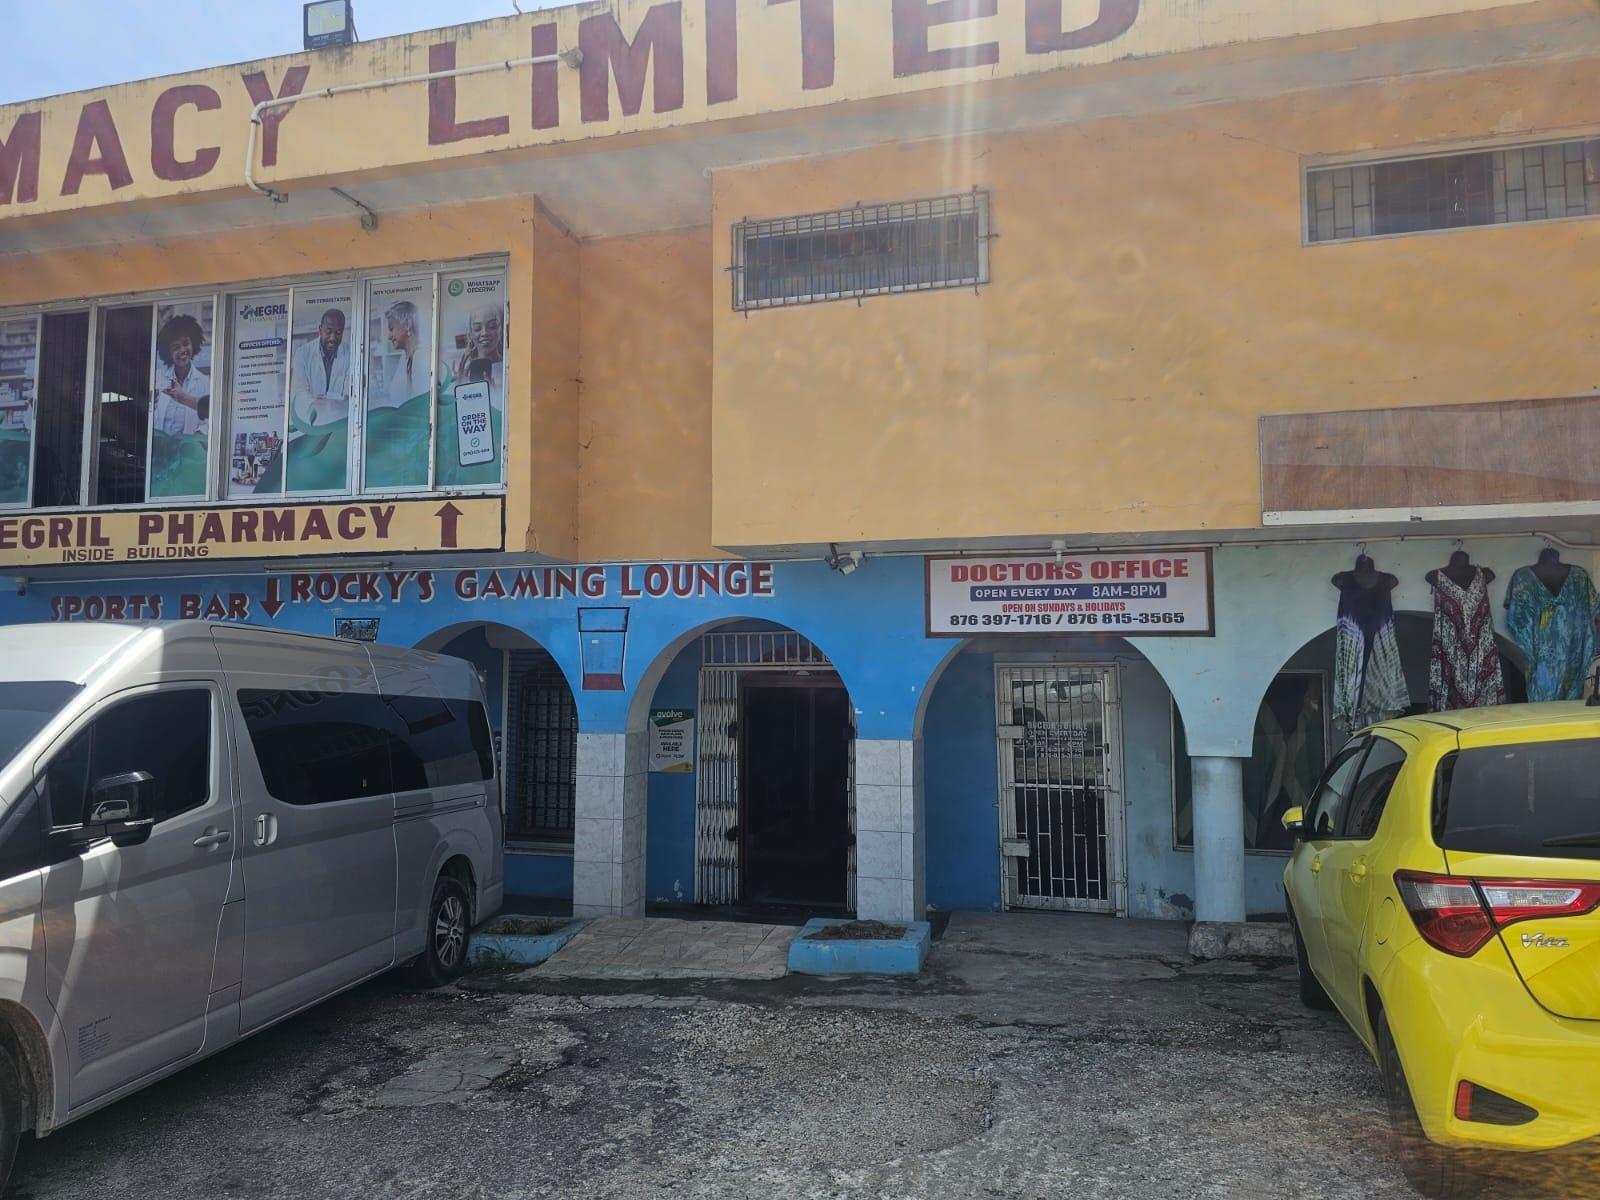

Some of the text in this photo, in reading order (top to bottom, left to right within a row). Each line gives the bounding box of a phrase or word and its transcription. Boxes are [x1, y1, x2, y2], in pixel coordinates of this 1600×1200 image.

[0, 65, 310, 204] MACY
[462, 412, 486, 421] ORDER
[463, 424, 487, 434] WAY
[0, 505, 396, 549] EGRIL PHARMACY
[62, 546, 209, 561] INSIDE BUILDING
[951, 559, 1189, 582] DOCTORS OFFICE
[290, 562, 775, 603] ROCKY'S GAMING LOUNGE
[975, 589, 1007, 598] OPEN
[1010, 588, 1050, 597] EVERY
[1053, 587, 1078, 597] DAY
[51, 592, 250, 621] SPORTS BAR
[1002, 602, 1126, 613] OPEN ON SUNDAYS & HOLIDAYS
[950, 612, 1185, 626] 876 397-1716 / 876 815-3565
[656, 710, 684, 718] evolve
